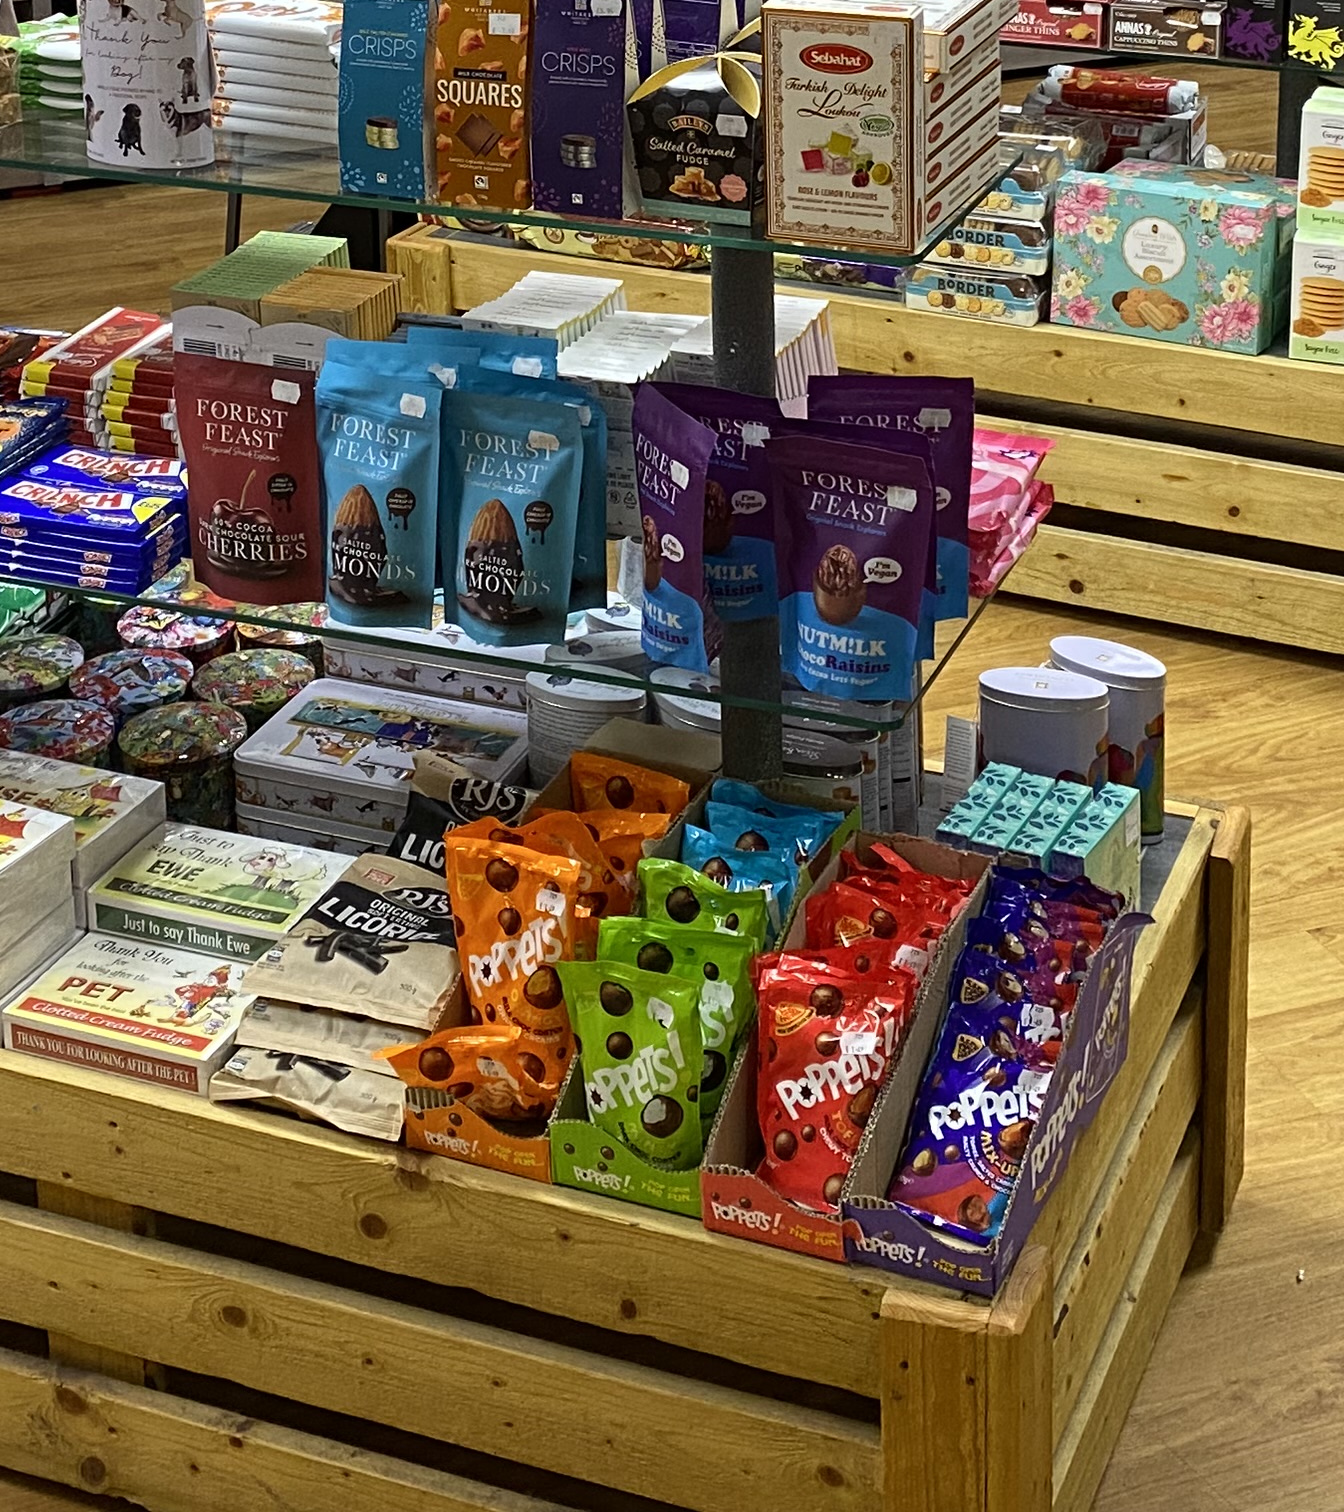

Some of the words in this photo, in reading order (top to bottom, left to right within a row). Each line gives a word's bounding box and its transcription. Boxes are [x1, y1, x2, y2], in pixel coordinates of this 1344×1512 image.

[348, 34, 417, 61] CRISPS
[809, 50, 862, 68] Sebahat
[540, 50, 616, 77] CRISPS
[436, 78, 523, 110] SQUARES
[784, 76, 828, 94] Turkish
[843, 80, 888, 100] Delight
[669, 115, 714, 134] BAILEYS
[649, 136, 684, 155] Salted
[686, 141, 737, 160] Caramel
[676, 154, 710, 166] FUDGE
[937, 277, 995, 298] BORDER
[196, 397, 289, 430] FOREST
[204, 421, 279, 452] FEAST
[330, 412, 416, 449] FOREST
[61, 451, 171, 474] CRUNCH
[334, 438, 404, 472] FEAST
[465, 453, 542, 484] FEAST
[10, 484, 124, 508] CRUNCH
[733, 499, 763, 510] Vegan
[809, 491, 892, 527] FEAST
[198, 528, 308, 562] CHERRIES
[215, 527, 273, 544] CHOCOLATE
[275, 533, 305, 545] SOUR
[343, 538, 372, 550] SALTED
[478, 553, 507, 566] SALTED
[867, 566, 898, 579] Vegan
[178, 828, 213, 846] Just
[217, 836, 235, 849] to
[145, 859, 205, 882] EWE
[368, 898, 430, 928] ORIGINAL
[123, 913, 146, 932] Just
[148, 920, 160, 936] to
[163, 925, 184, 944] say
[186, 926, 223, 950] Thank
[226, 937, 251, 955] Ewe
[93, 939, 140, 959] Thank
[142, 949, 174, 966] You
[110, 957, 129, 967] for
[468, 914, 567, 998] POPPETS!
[57, 975, 135, 1003] PET
[32, 1001, 89, 1021] Clotted
[87, 1015, 143, 1035] Cream
[139, 1028, 193, 1046] Fudge
[16, 1030, 46, 1050] THANK
[47, 1037, 66, 1054] YOU
[66, 1043, 85, 1060] FOR
[85, 1046, 125, 1069] LOOKING
[126, 1057, 154, 1076] AFTER
[154, 1063, 173, 1080] THE
[173, 1068, 190, 1083] PET
[423, 1128, 481, 1158] POPPETS!
[573, 1164, 632, 1192] POPPETS!
[711, 1200, 785, 1235] POPPETS!
